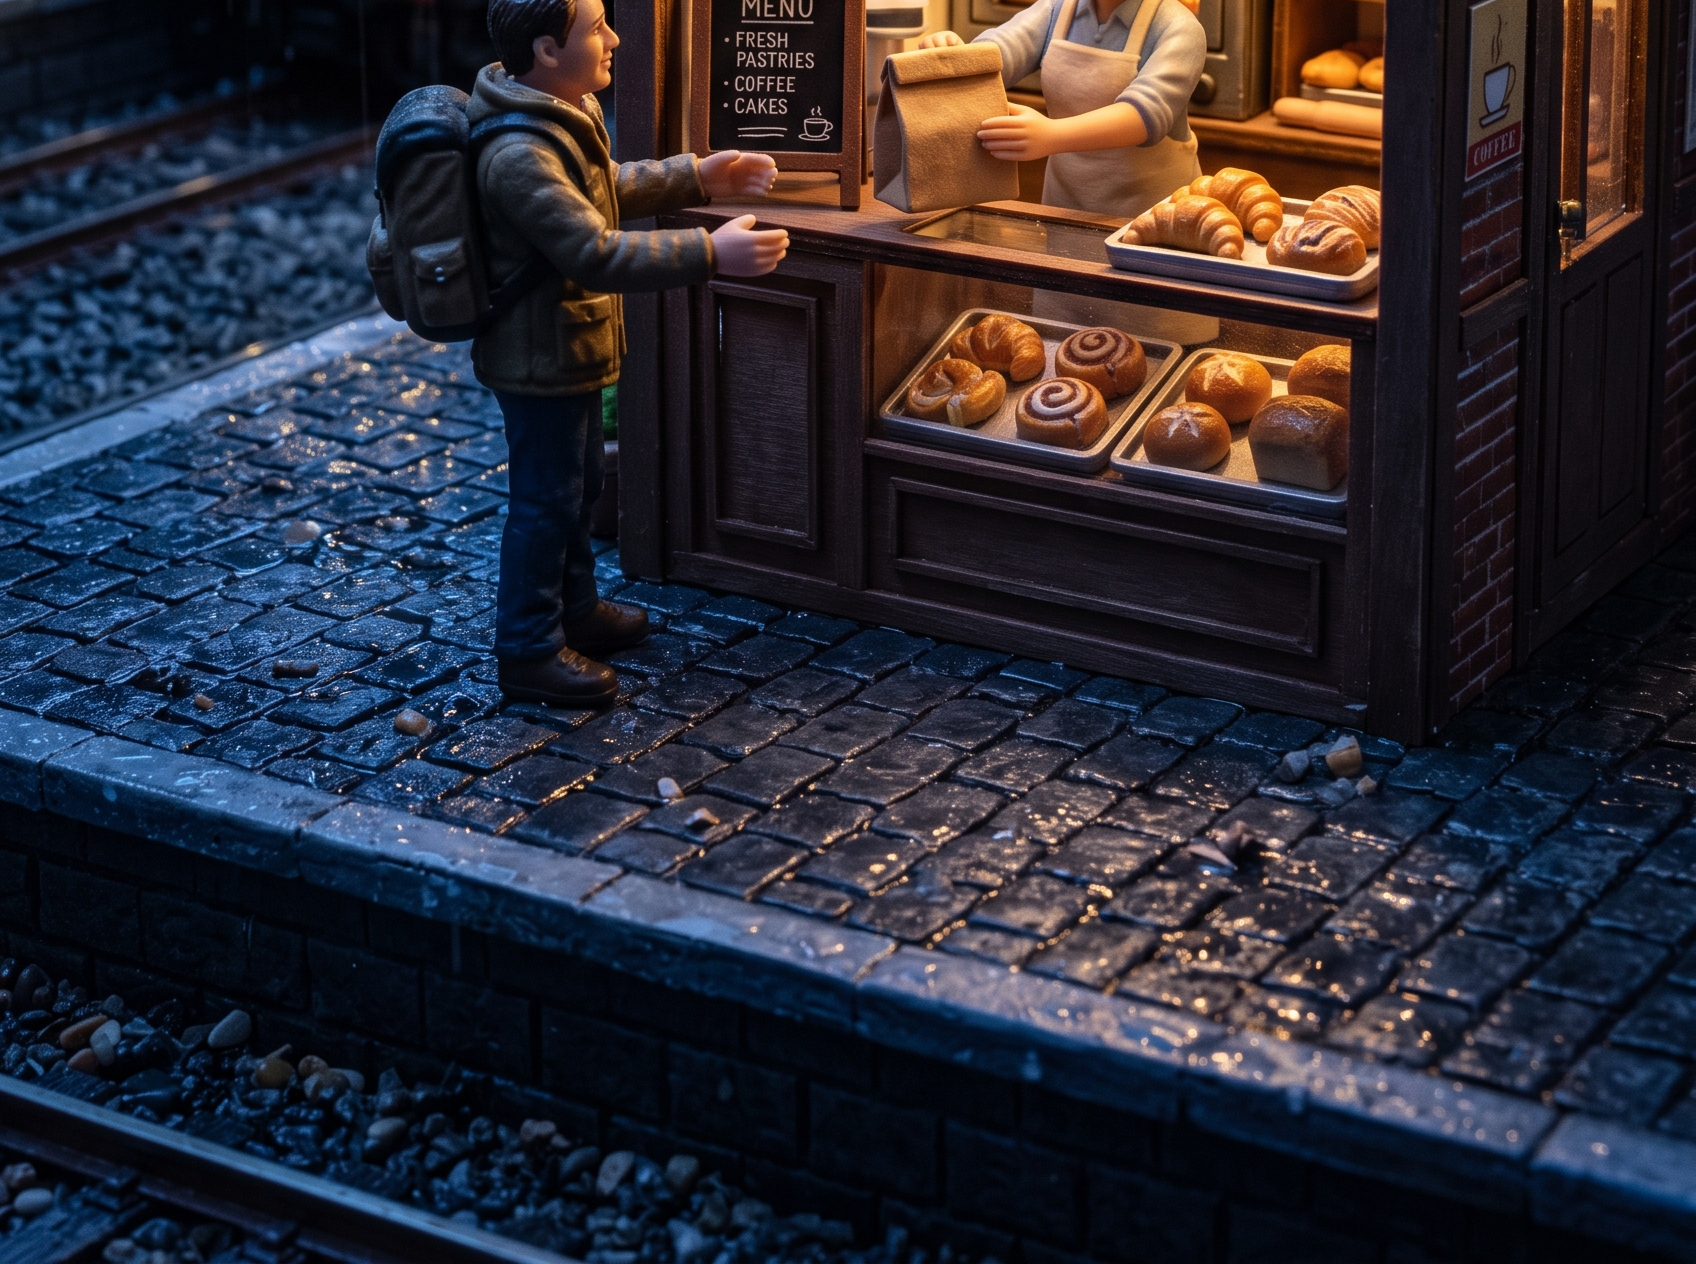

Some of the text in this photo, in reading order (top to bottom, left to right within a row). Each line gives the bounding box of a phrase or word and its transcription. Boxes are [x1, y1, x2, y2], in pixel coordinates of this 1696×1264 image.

[736, 31, 789, 49] FRESH
[736, 51, 815, 69] PASTRIES
[734, 75, 796, 93] COFFEE
[734, 97, 788, 115] CAKES
[1473, 129, 1516, 167] COFFEE
